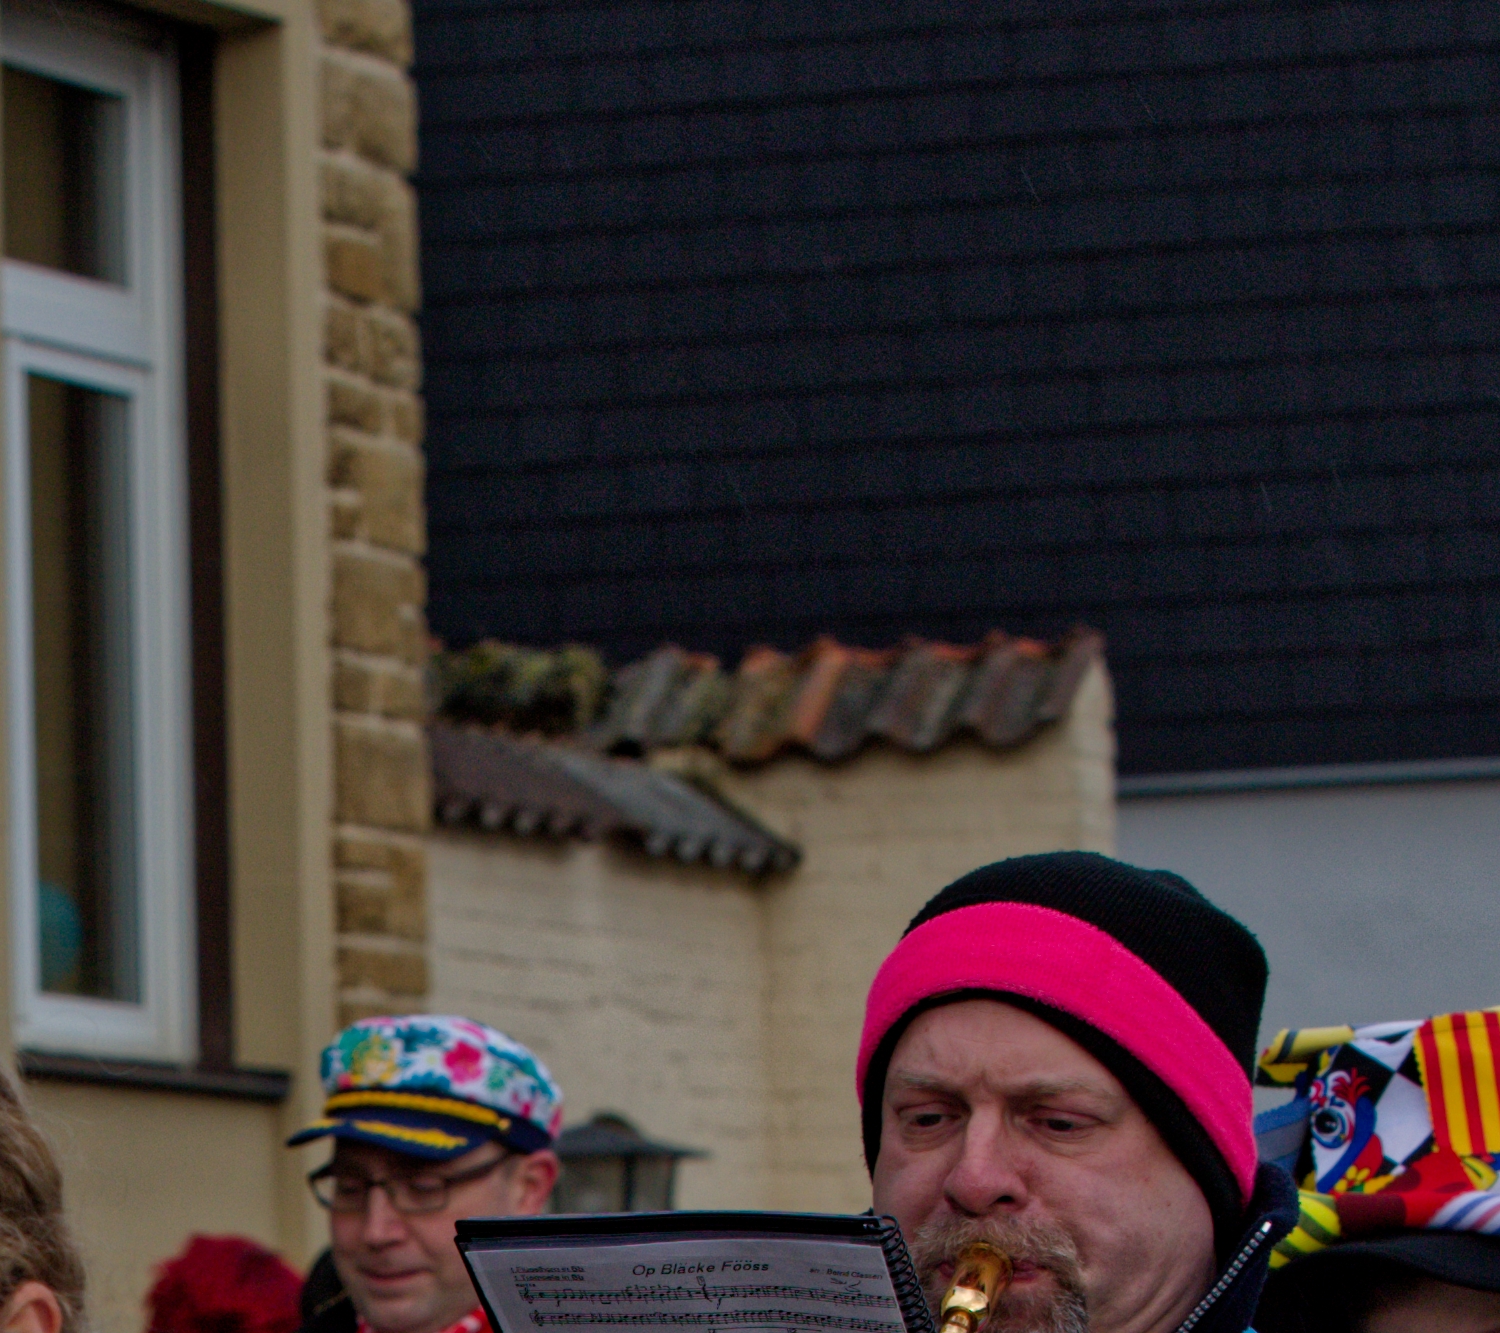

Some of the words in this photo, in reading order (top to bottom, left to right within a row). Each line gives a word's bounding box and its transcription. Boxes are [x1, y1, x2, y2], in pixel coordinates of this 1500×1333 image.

[631, 1264, 656, 1278] Op
[660, 1261, 716, 1275] Bläcke
[721, 1259, 770, 1272] Fööss
